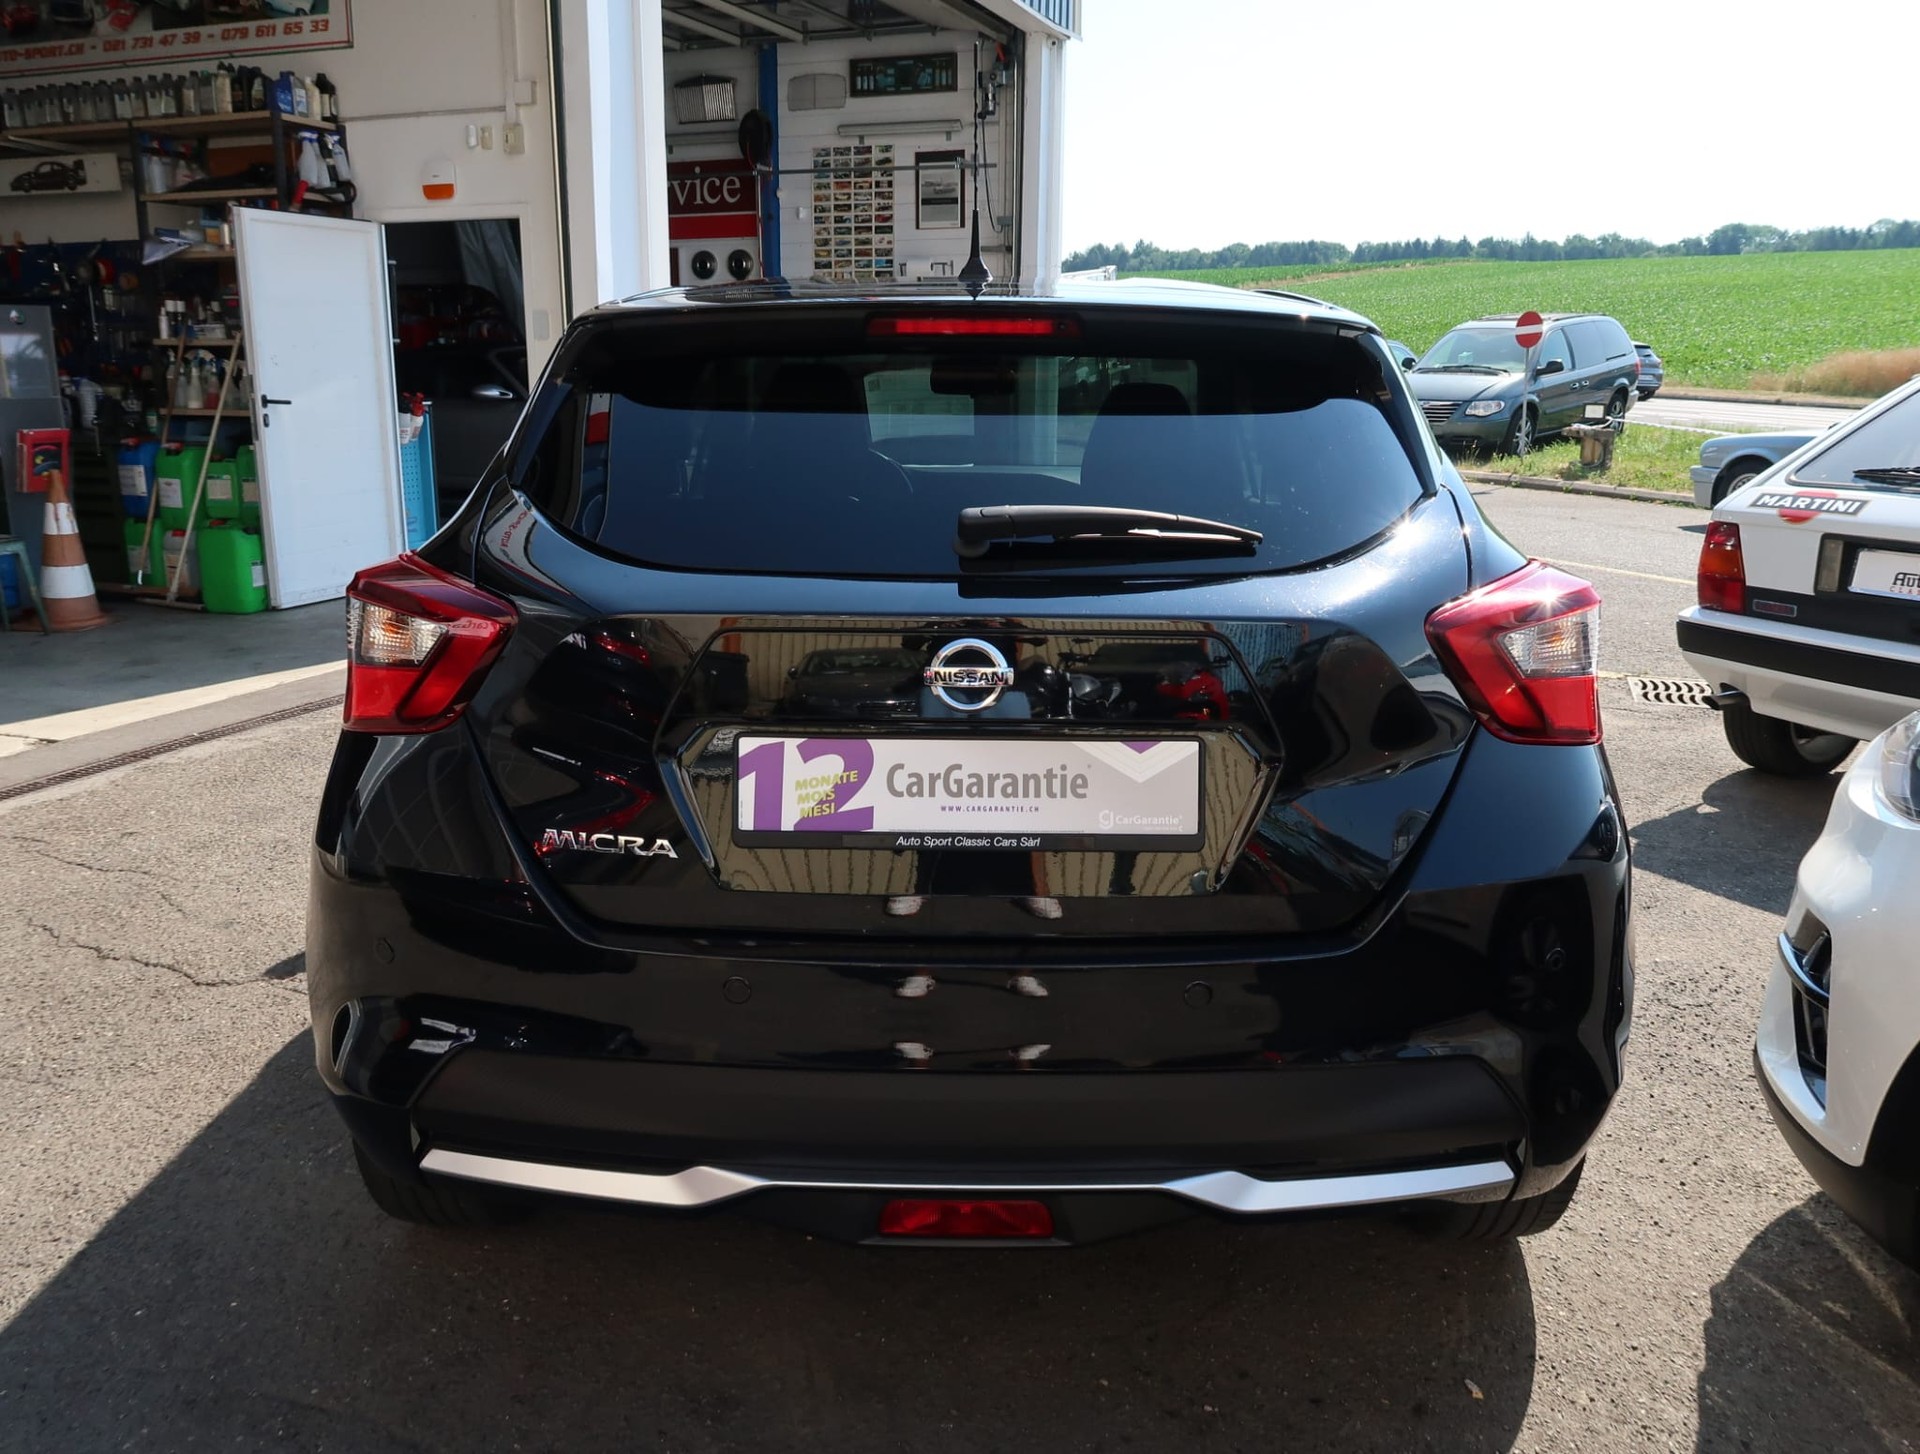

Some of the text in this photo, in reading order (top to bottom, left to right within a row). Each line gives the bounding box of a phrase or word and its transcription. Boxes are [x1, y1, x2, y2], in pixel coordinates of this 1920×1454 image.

[132, 37, 153, 49] 731
[159, 34, 177, 46] 47
[182, 31, 200, 44] 39
[221, 27, 248, 41] 079
[256, 24, 275, 38] 611
[284, 22, 303, 35] 65
[310, 19, 329, 33] 33
[668, 166, 741, 206] vice
[1756, 494, 1861, 513] MARTINI
[934, 671, 1005, 683] NISSAN
[739, 738, 875, 831] 12
[795, 770, 858, 791] MONATE
[886, 763, 1089, 799] CarGarantie
[797, 788, 835, 805] MOIS
[800, 803, 835, 818] MESI
[941, 805, 1039, 813] WWW.CARGARANTIE.CH
[542, 828, 679, 859] MICRA
[896, 836, 1040, 848] Auto Sport Classic Cars Sàrl
